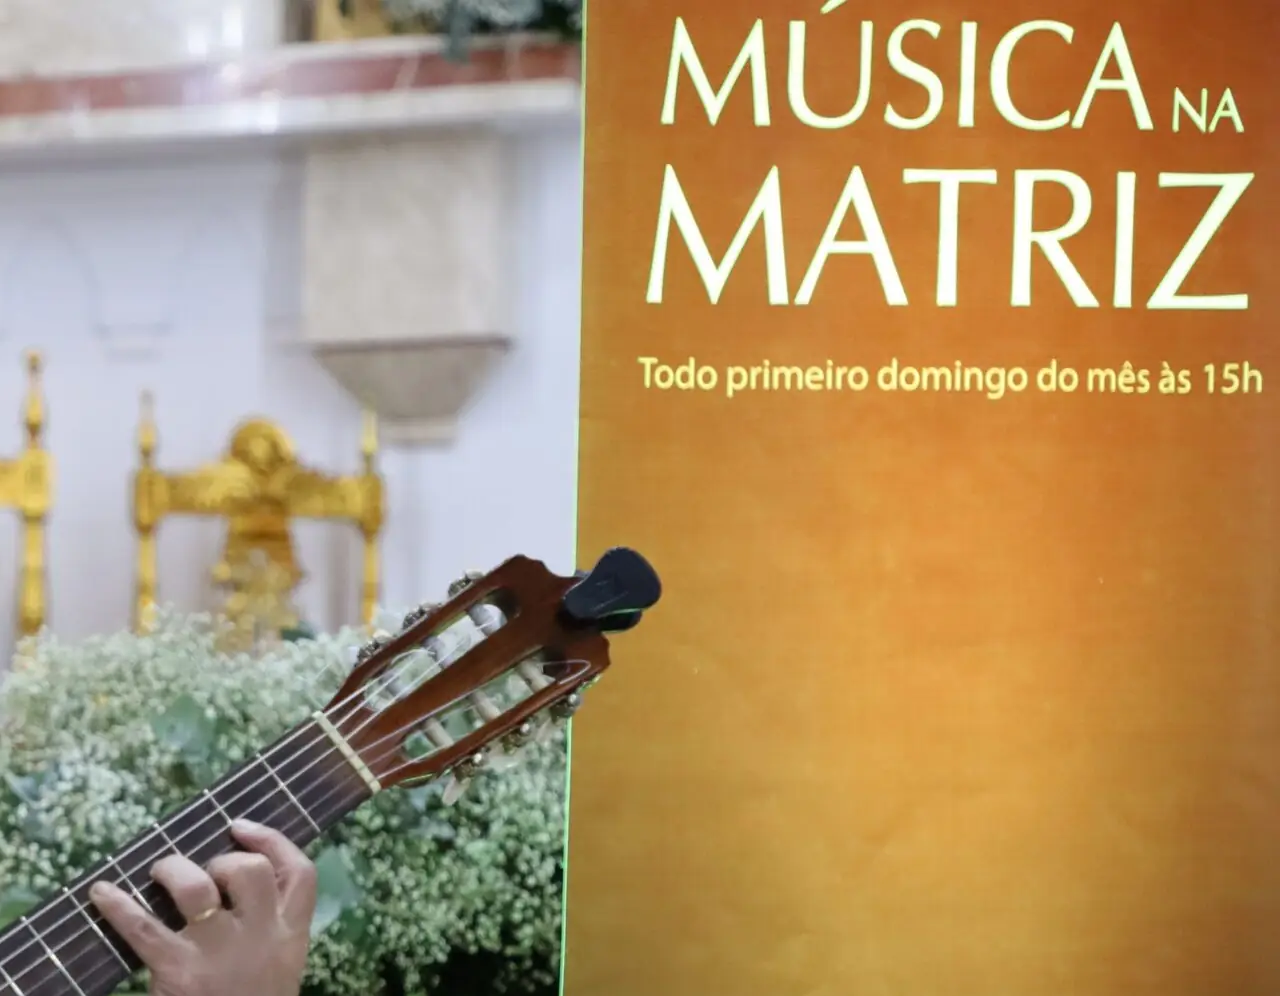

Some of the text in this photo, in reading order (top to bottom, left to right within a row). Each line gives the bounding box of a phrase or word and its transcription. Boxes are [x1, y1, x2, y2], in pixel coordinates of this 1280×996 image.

[660, 0, 1245, 133] MÚSICA NA
[645, 164, 1255, 309] MATRIZ
[637, 356, 1263, 400] Todo primeiro domingo do mês às 15h
